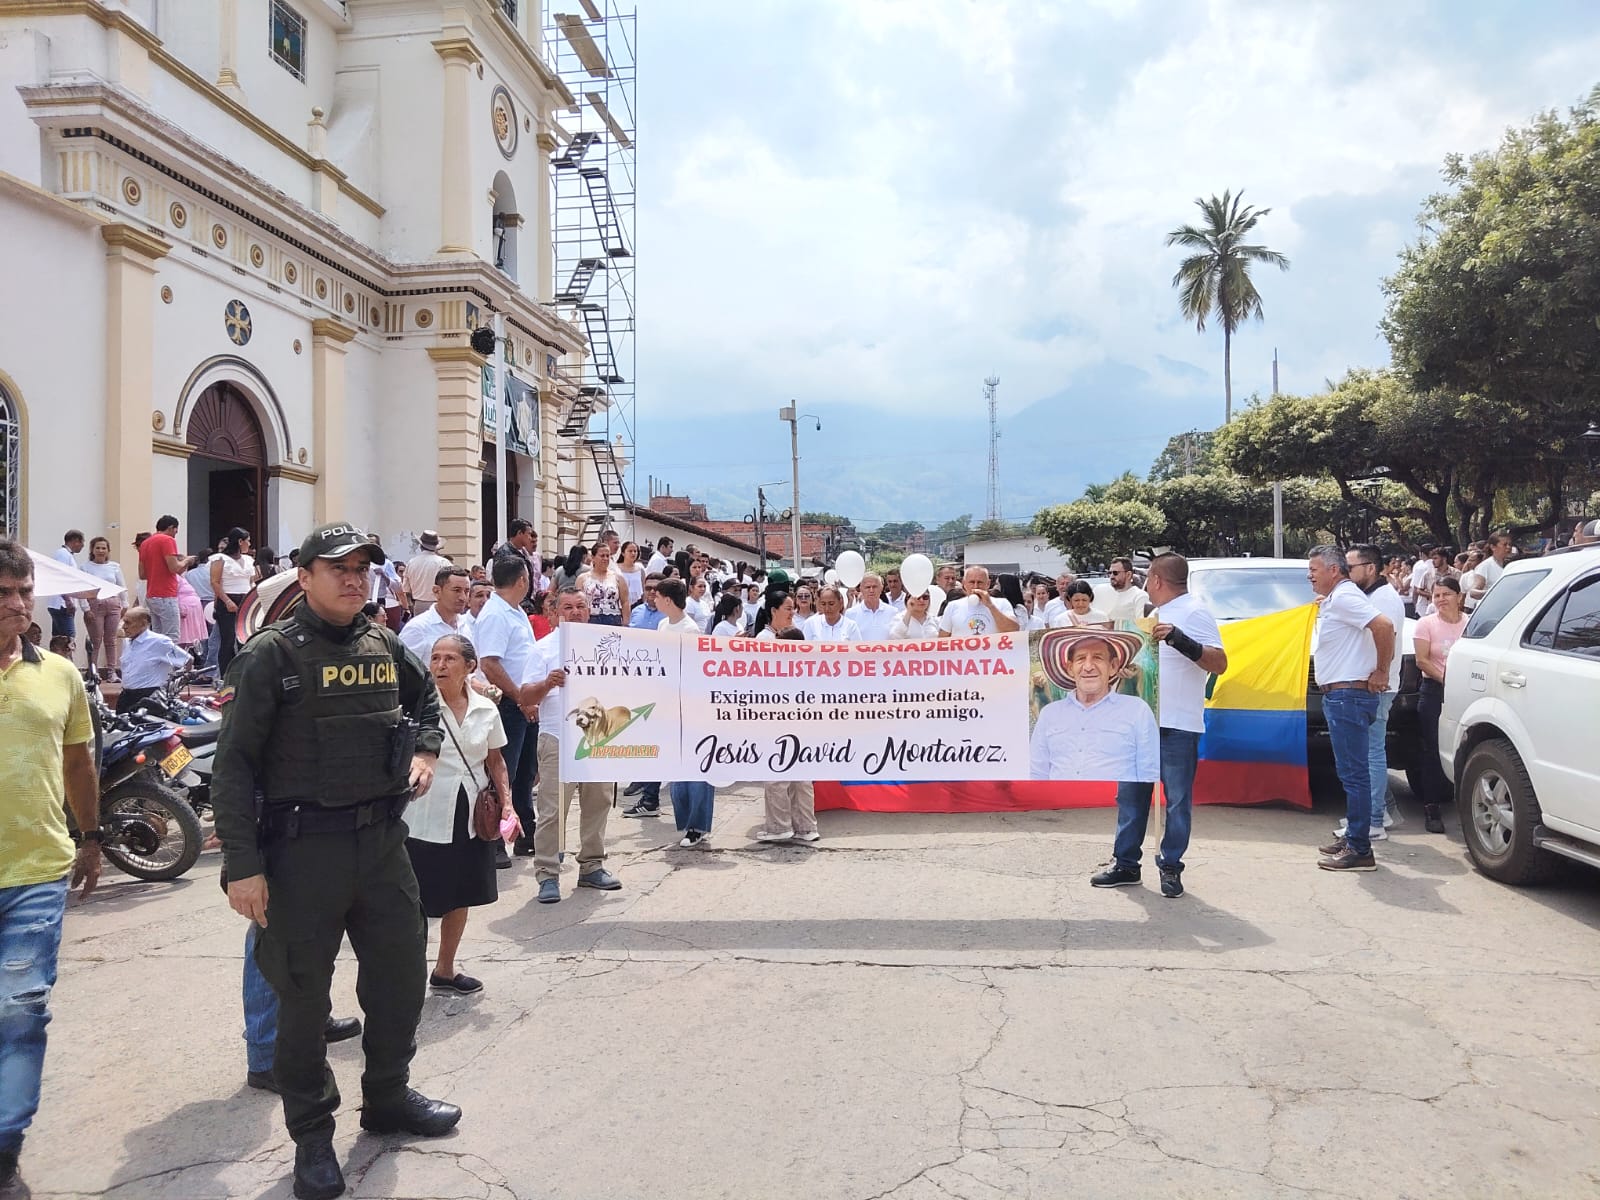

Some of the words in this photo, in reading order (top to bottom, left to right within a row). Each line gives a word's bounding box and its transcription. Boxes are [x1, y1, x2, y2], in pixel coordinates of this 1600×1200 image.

[698, 637, 722, 652] EL
[728, 640, 814, 653] GREMIO
[820, 644, 849, 653] DE
[855, 637, 991, 653] GANADEROS
[997, 635, 1014, 651] &
[322, 663, 398, 688] POLICIA
[563, 665, 667, 677] SARDINATA
[702, 660, 842, 677] CABALLISTAS
[848, 660, 876, 677] DE
[882, 658, 1015, 677] SARDINATA.
[710, 689, 790, 707] Exigimos
[795, 690, 816, 704] de
[821, 692, 887, 704] manera
[892, 688, 985, 703] inmediata,
[716, 708, 732, 721] la
[736, 708, 823, 721] liberación
[828, 708, 849, 721] de
[855, 707, 921, 720] nuestro
[925, 705, 984, 722] amigo.
[695, 734, 763, 773] Jesús
[768, 733, 856, 773] David
[863, 736, 1008, 775] Montañez.
